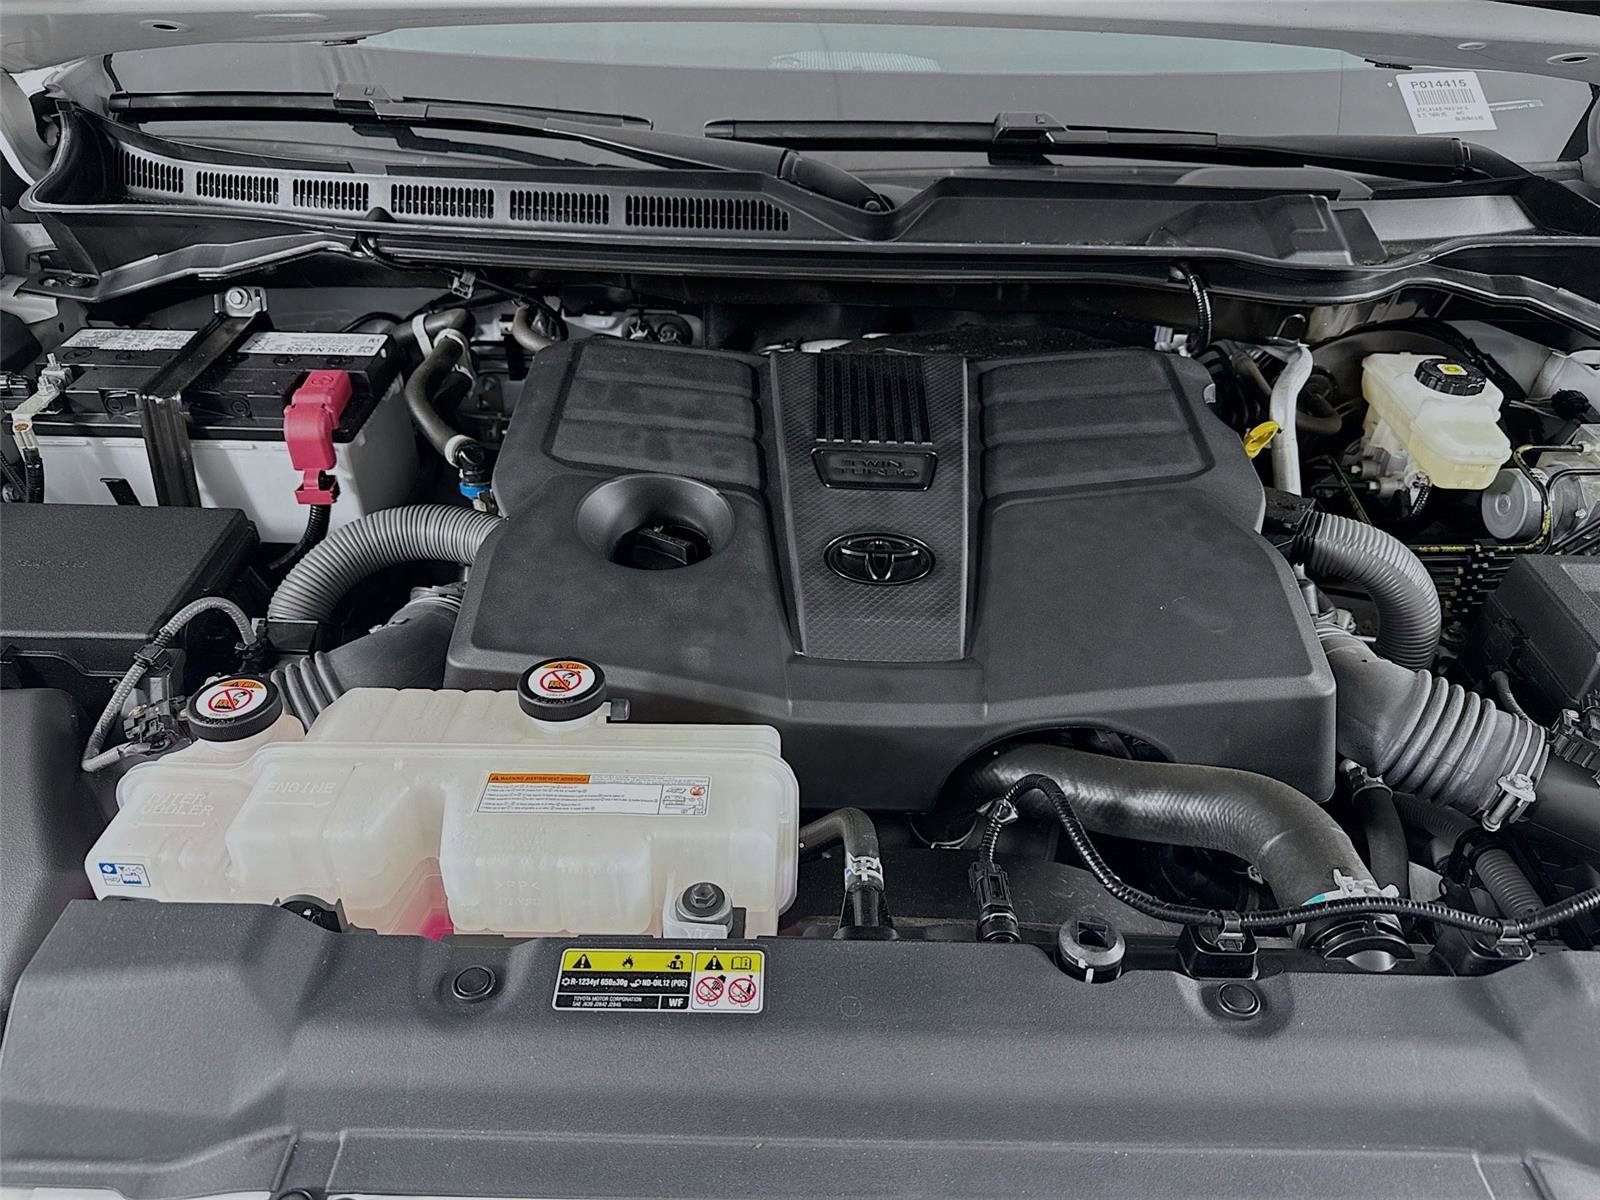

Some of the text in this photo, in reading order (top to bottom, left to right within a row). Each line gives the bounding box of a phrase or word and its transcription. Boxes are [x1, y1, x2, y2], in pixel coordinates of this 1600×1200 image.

[1410, 79, 1467, 89] P014415
[265, 782, 337, 793] ENGINE
[669, 998, 684, 1007] WF
